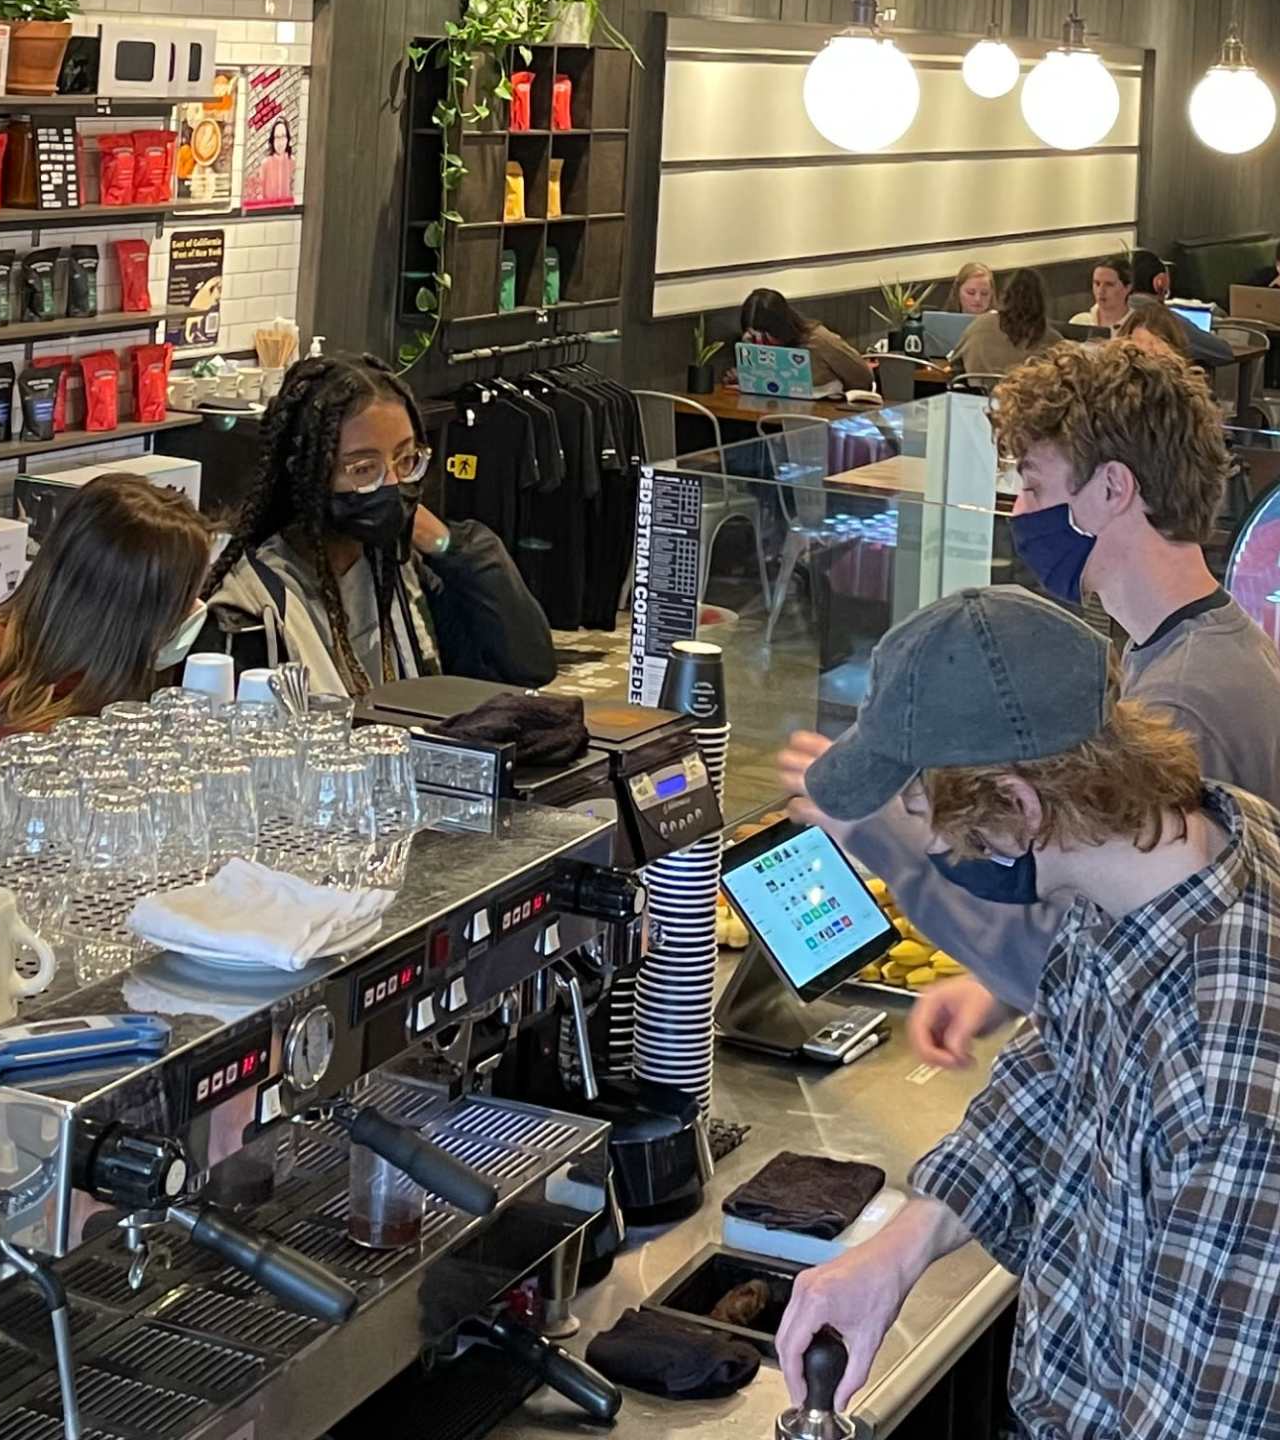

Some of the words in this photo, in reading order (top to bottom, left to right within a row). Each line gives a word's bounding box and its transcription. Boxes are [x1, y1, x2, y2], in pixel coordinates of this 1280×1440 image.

[635, 466, 654, 585] PEDESTRIAN
[632, 584, 648, 656] COFFEE
[630, 652, 647, 706] PEDE
